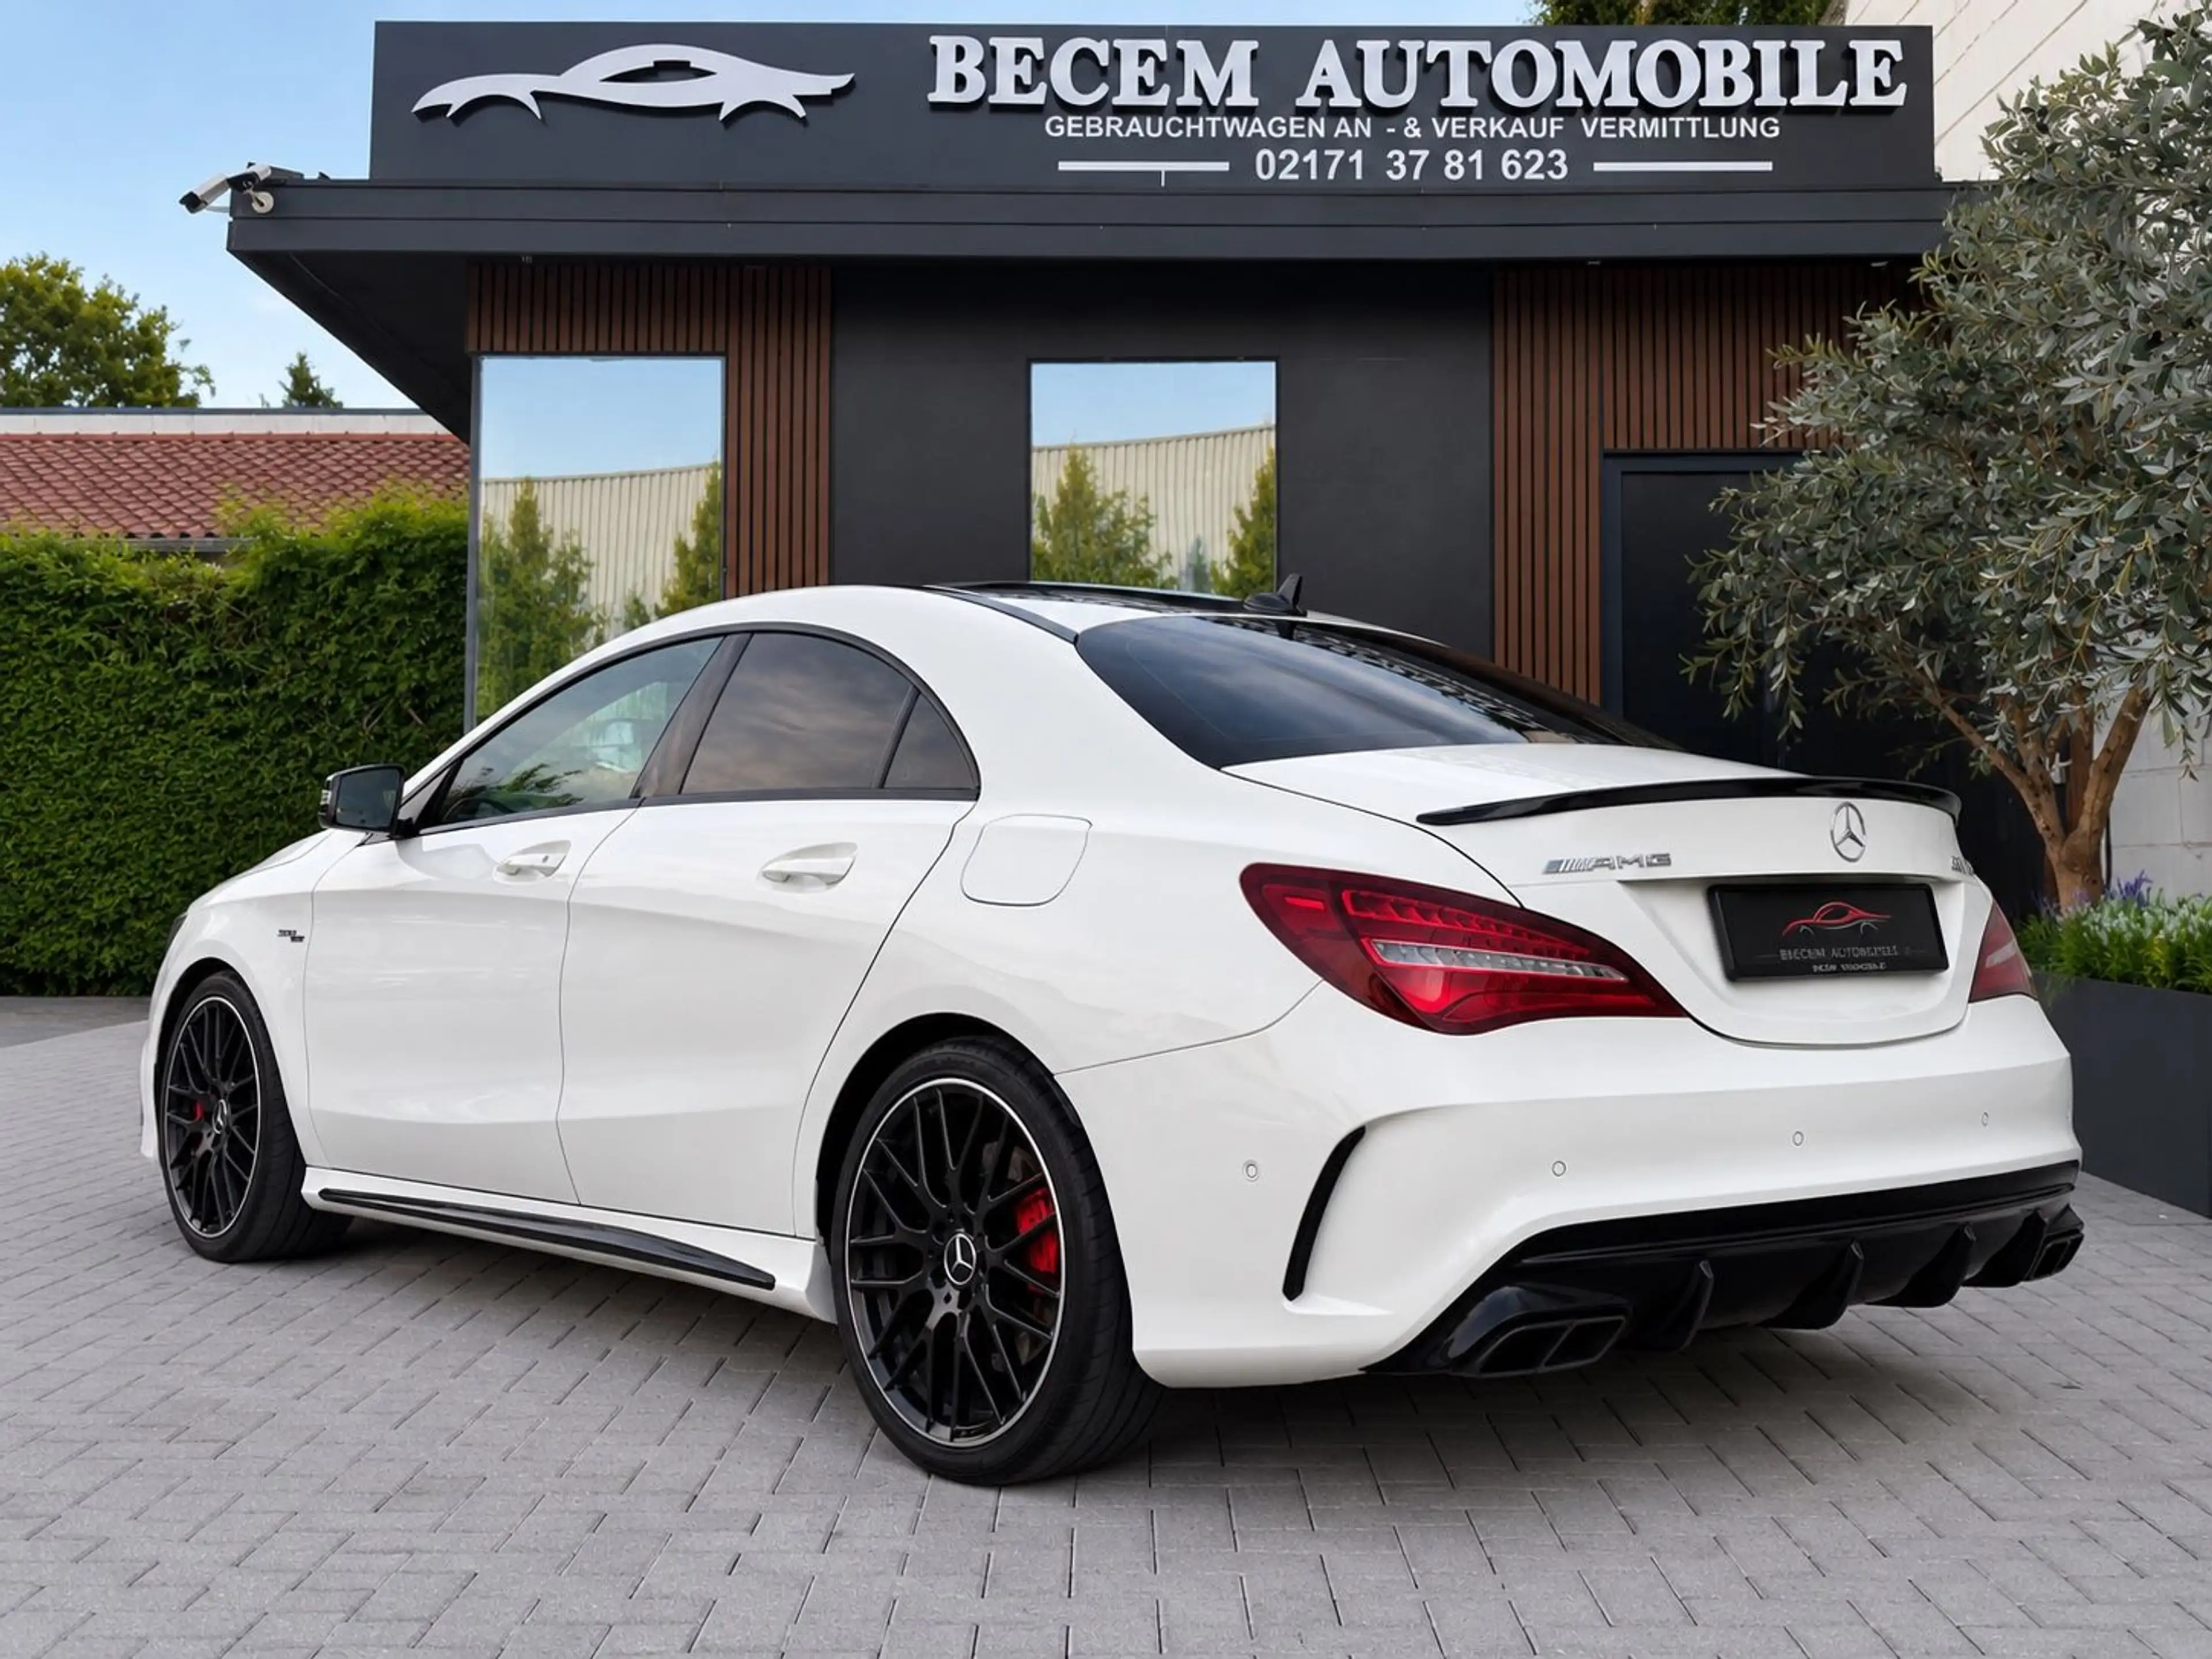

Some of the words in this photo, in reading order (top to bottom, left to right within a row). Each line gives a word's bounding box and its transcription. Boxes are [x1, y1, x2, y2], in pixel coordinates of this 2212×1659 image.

[927, 35, 1260, 108] BECEM
[1294, 39, 1908, 108] AUTOMOBILE
[1045, 115, 1325, 138] GEBRAUCHTWAGEN
[1334, 116, 1372, 138] AN
[1403, 116, 1422, 139] &
[1431, 116, 1564, 139] VERKAUF
[1581, 116, 1780, 139] VERMITTLUNG
[1255, 147, 1363, 181] 02171
[1385, 149, 1430, 181] 37
[1443, 148, 1483, 181] 81
[1501, 148, 1569, 181] 623
